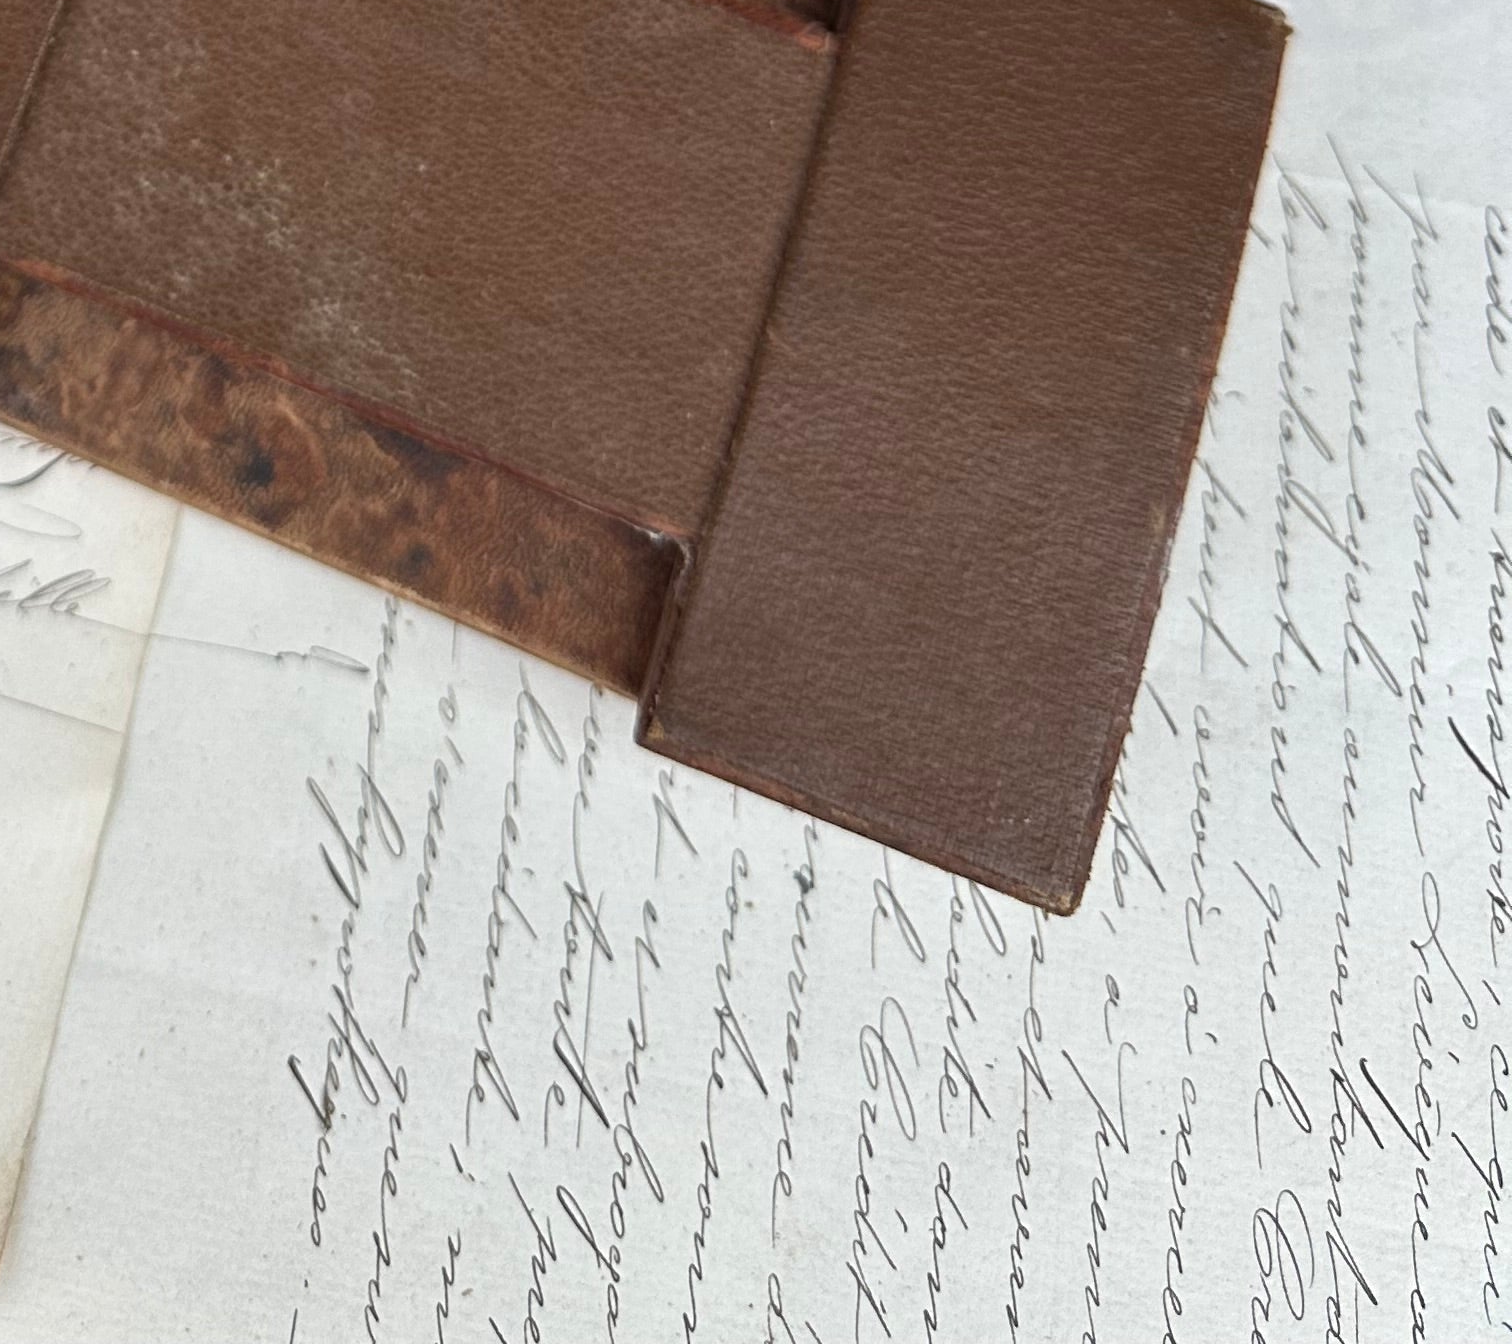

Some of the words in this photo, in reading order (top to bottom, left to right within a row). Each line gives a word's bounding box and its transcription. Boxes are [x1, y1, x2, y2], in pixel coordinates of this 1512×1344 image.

[1407, 412, 1461, 855] Monsieur
[369, 1038, 408, 1198] que
[545, 881, 613, 1149] toute
[711, 847, 768, 1101] contre
[556, 1018, 665, 1344] subroga
[845, 995, 920, 1344] Crédit
